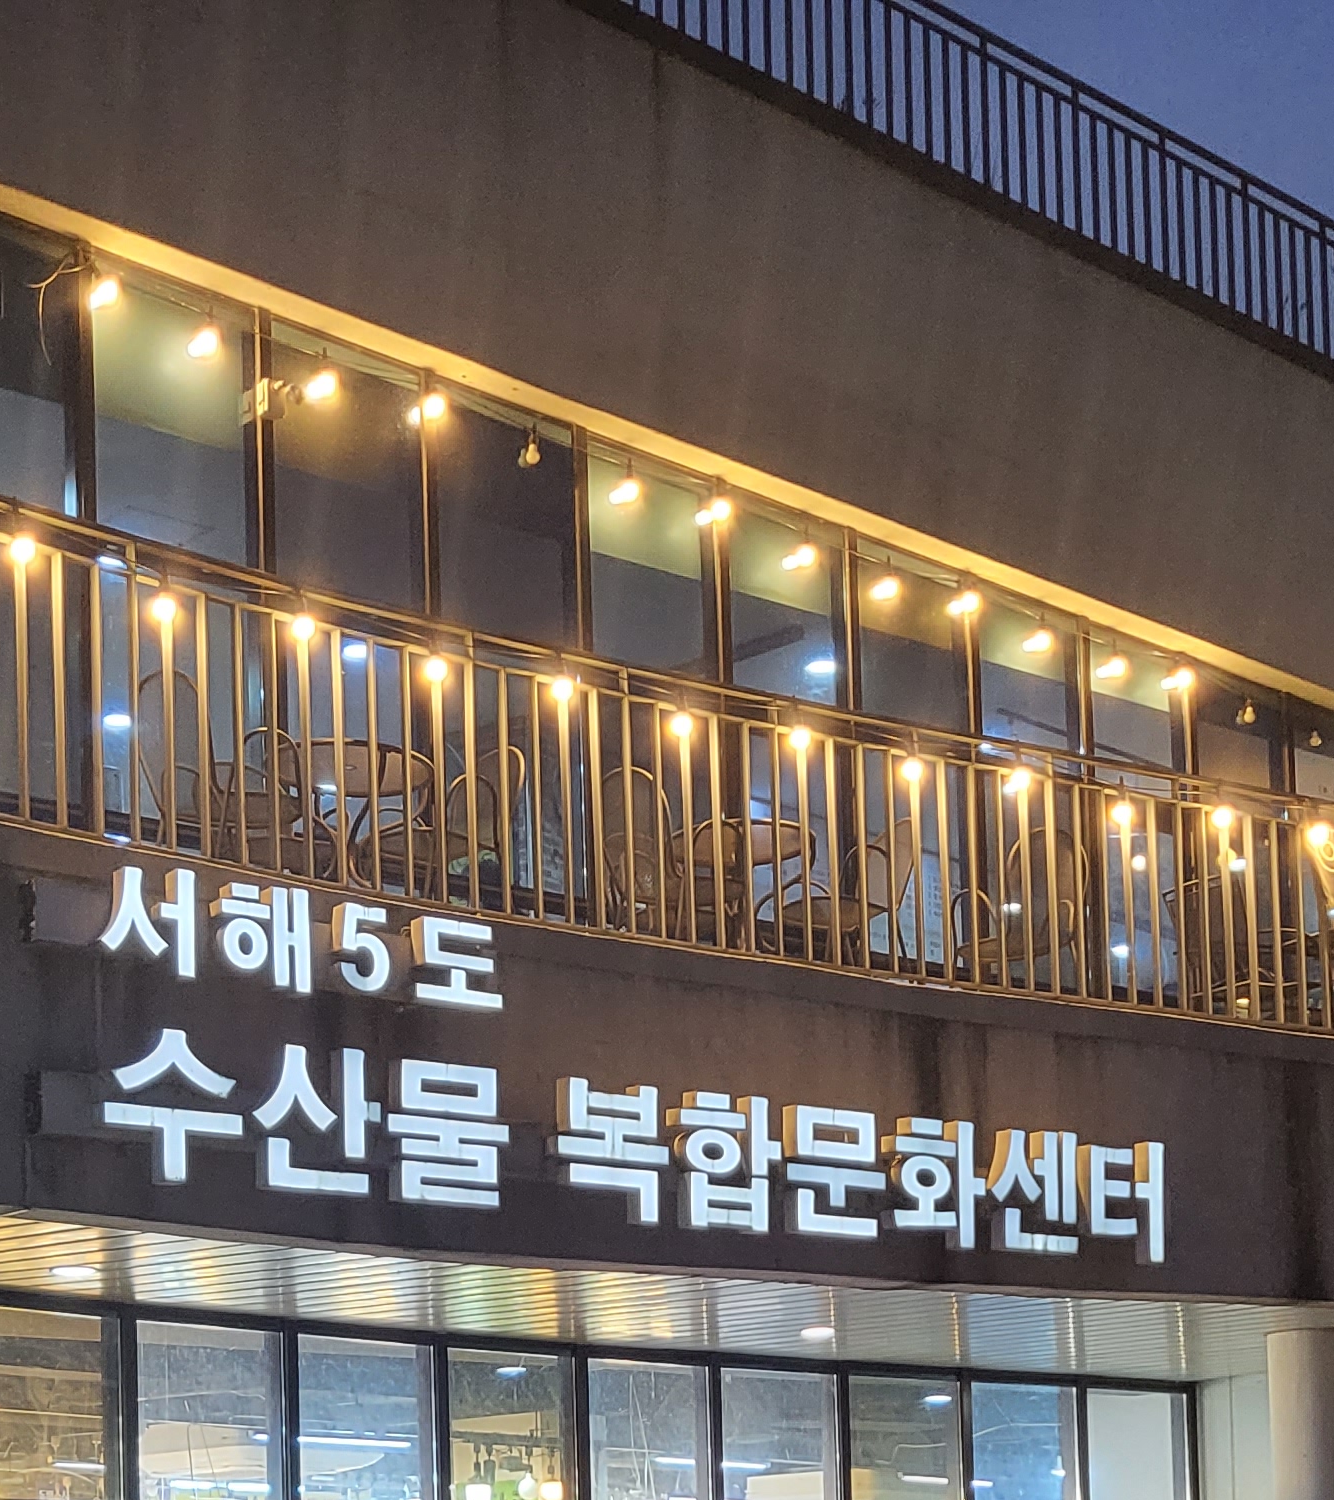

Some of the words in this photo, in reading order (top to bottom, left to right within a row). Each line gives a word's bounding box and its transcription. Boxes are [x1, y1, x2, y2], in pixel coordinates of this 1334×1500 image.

[100, 864, 505, 1009] 서해5도
[102, 1028, 510, 1208] 수산물
[547, 1073, 1165, 1263] 복합문화센터
